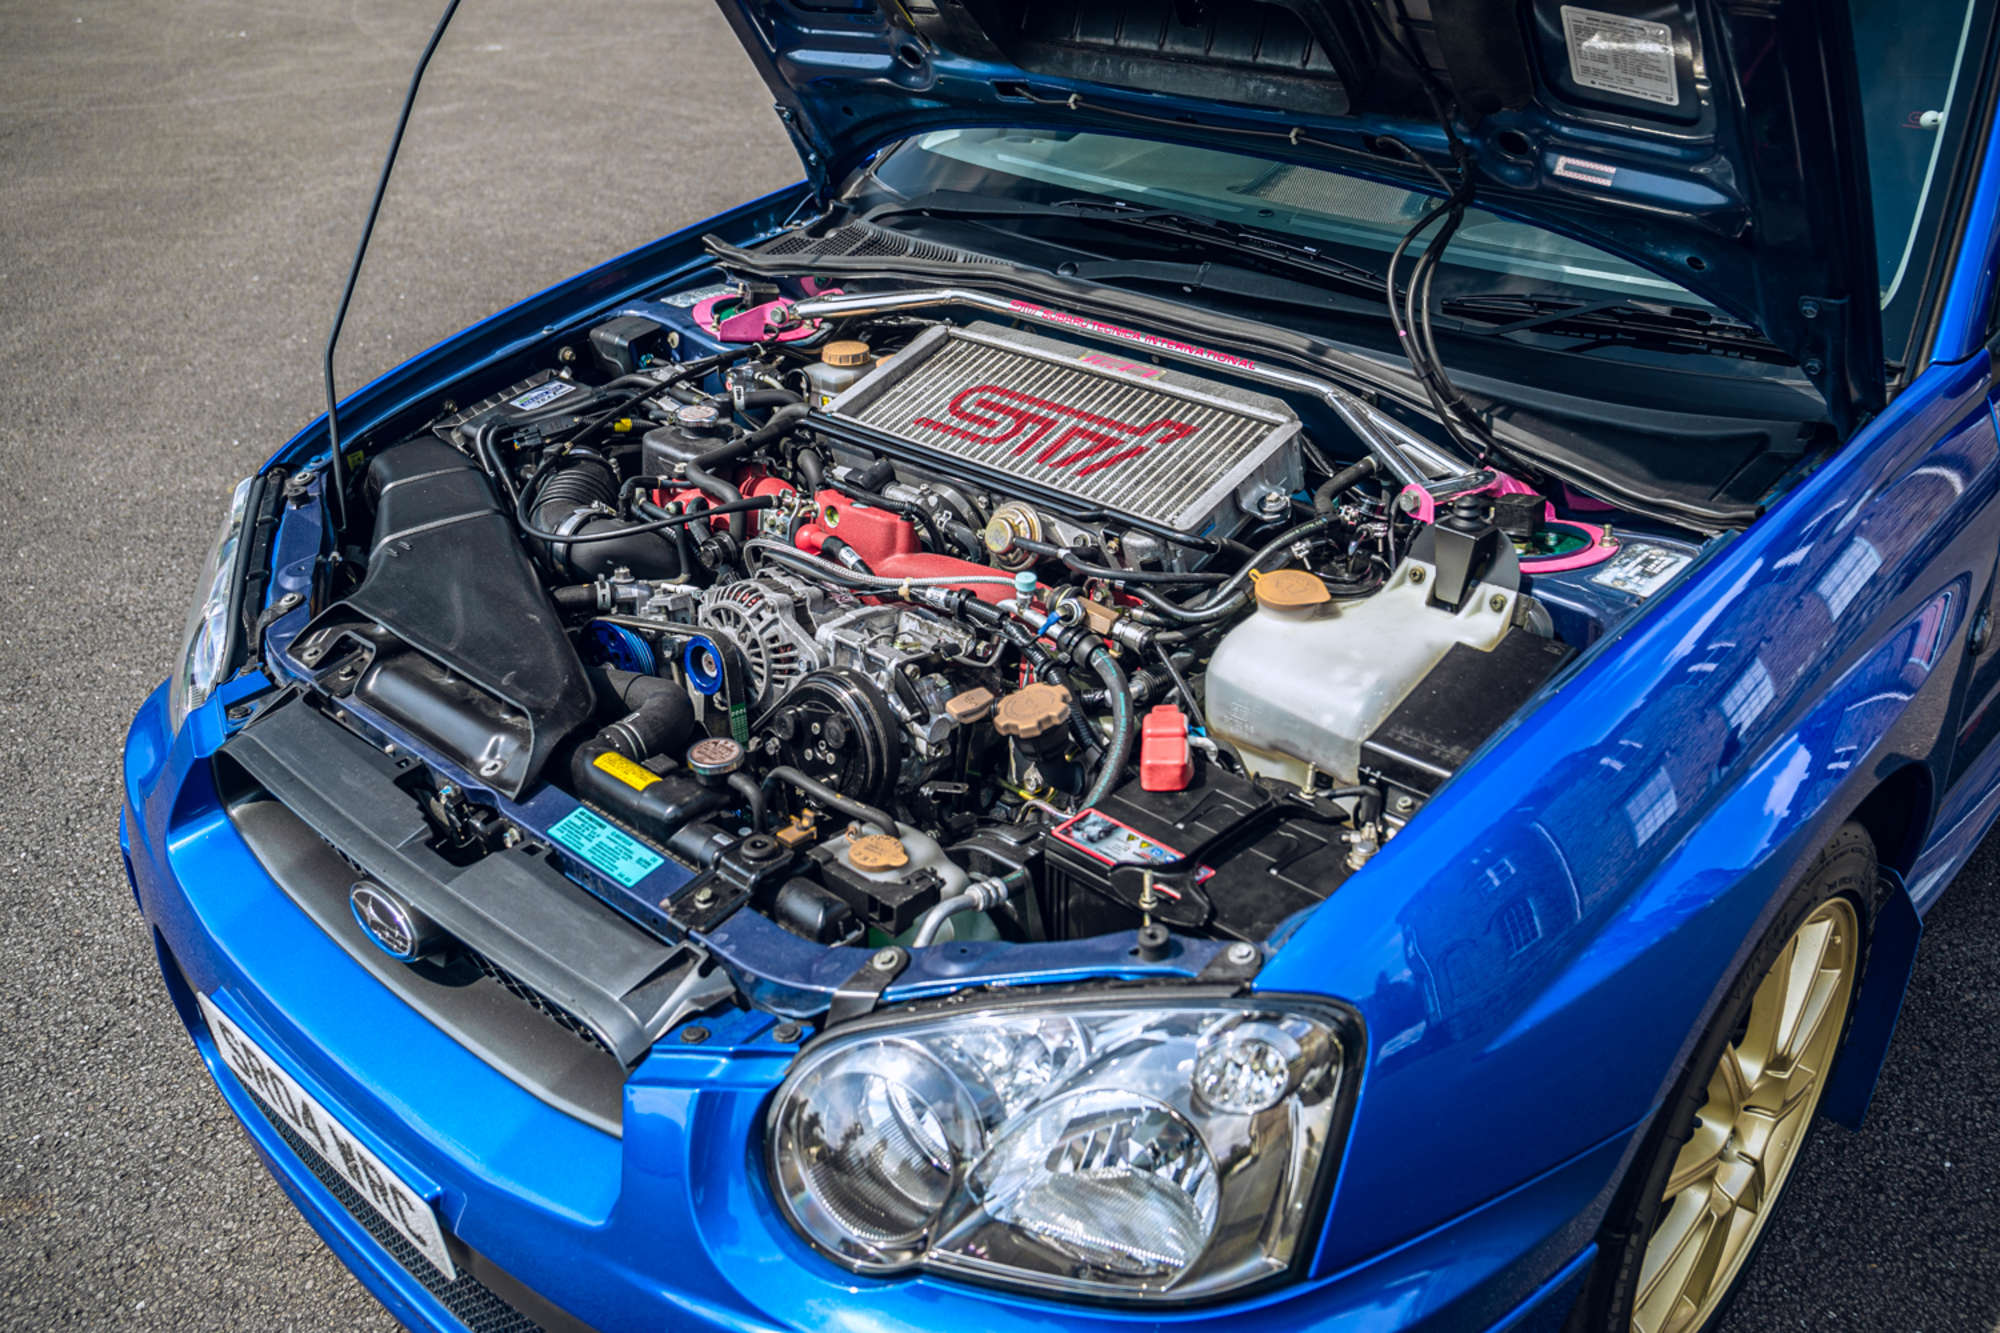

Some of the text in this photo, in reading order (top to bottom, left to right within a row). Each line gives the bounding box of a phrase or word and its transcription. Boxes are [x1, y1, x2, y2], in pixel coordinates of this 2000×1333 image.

[1041, 309, 1090, 329] SUBARU
[1089, 320, 1141, 340] TECNICA
[1144, 334, 1257, 370] INTERNATIONAL
[327, 1122, 428, 1247] WRC
